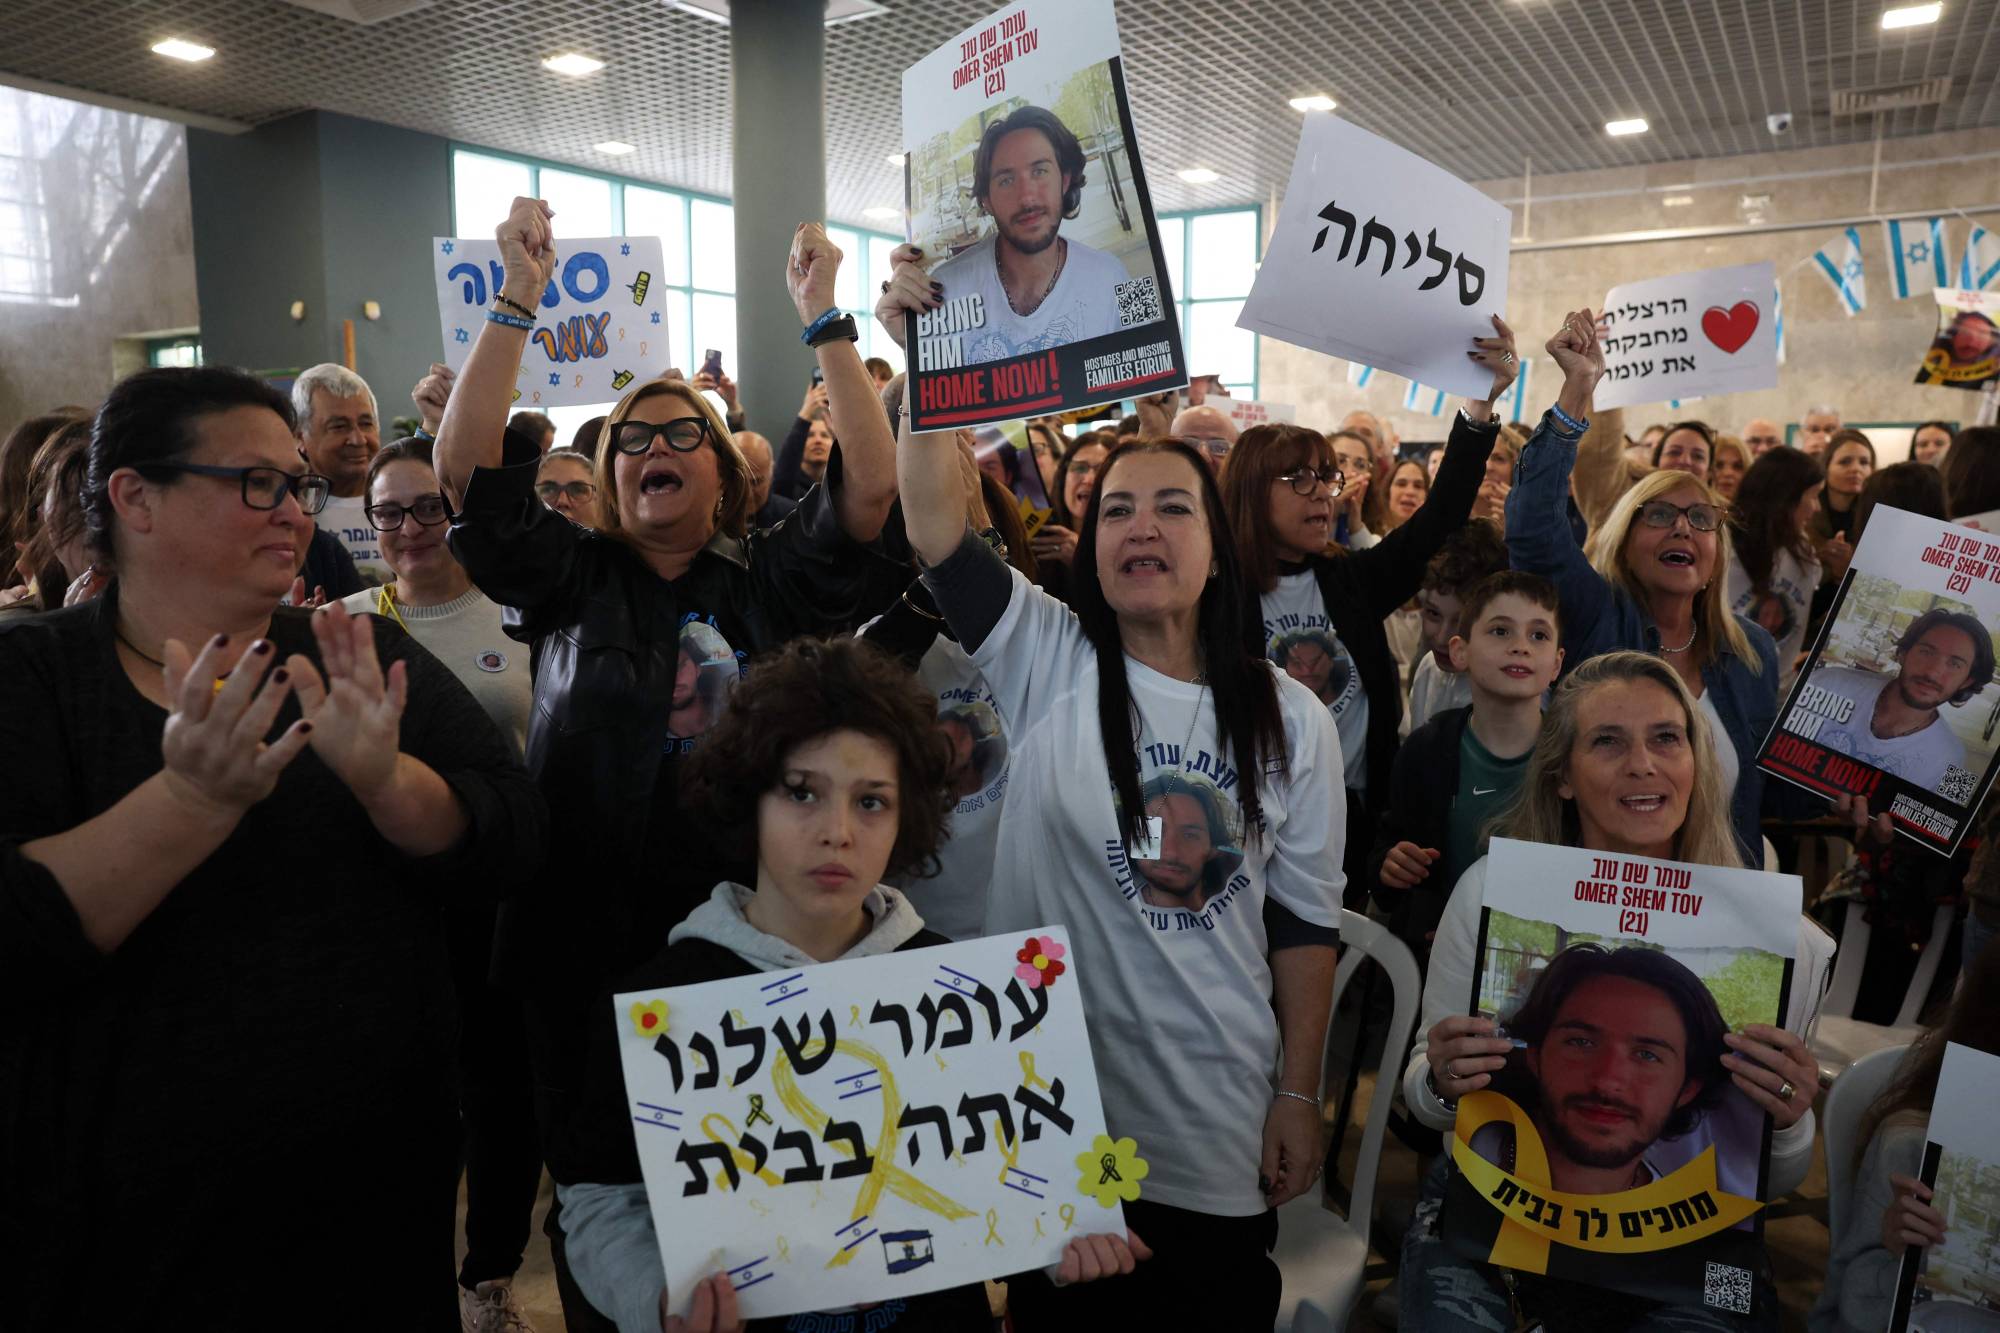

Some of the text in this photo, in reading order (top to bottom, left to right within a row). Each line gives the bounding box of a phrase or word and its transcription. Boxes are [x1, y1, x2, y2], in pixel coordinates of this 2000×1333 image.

[960, 10, 1027, 63] עומר שם טוב
[953, 28, 1038, 90] OMER SHEM TOV
[984, 68, 1005, 99] (21)
[1312, 200, 1485, 306] סליחה
[916, 292, 985, 338] BRING
[532, 311, 611, 363] עומר
[917, 335, 963, 373] HIM
[1605, 327, 1688, 355] מחבקת
[1084, 340, 1171, 371] HOSTAGES AND MISSING
[1086, 353, 1174, 389] FAMILIES FORUM
[1662, 355, 1696, 374] את
[919, 350, 1061, 412] HOME NOW!
[1938, 532, 1961, 551] טוב
[1960, 538, 1983, 557] שם
[1921, 546, 1955, 570] OMER
[1955, 556, 1990, 580] SHEM
[1946, 572, 1972, 595] (21)
[1795, 684, 1855, 725] BRING
[1782, 706, 1825, 741] HIM
[1145, 743, 1180, 768] עוד
[1769, 734, 1882, 798] HOME NOW!
[1889, 801, 1954, 840] FAMILIES FORUM
[1894, 792, 1958, 829] HOSTAGES AND MISSING
[1591, 858, 1692, 889] עומר שם טוב
[1574, 880, 1703, 916] OMER SHEM TOV
[1177, 912, 1201, 931] את
[1619, 909, 1649, 936] (21)
[653, 977, 1049, 1094] עומר שלנו
[675, 1077, 1075, 1198] אתה בבית
[1491, 1177, 1719, 1241] מחכים לך בבית
